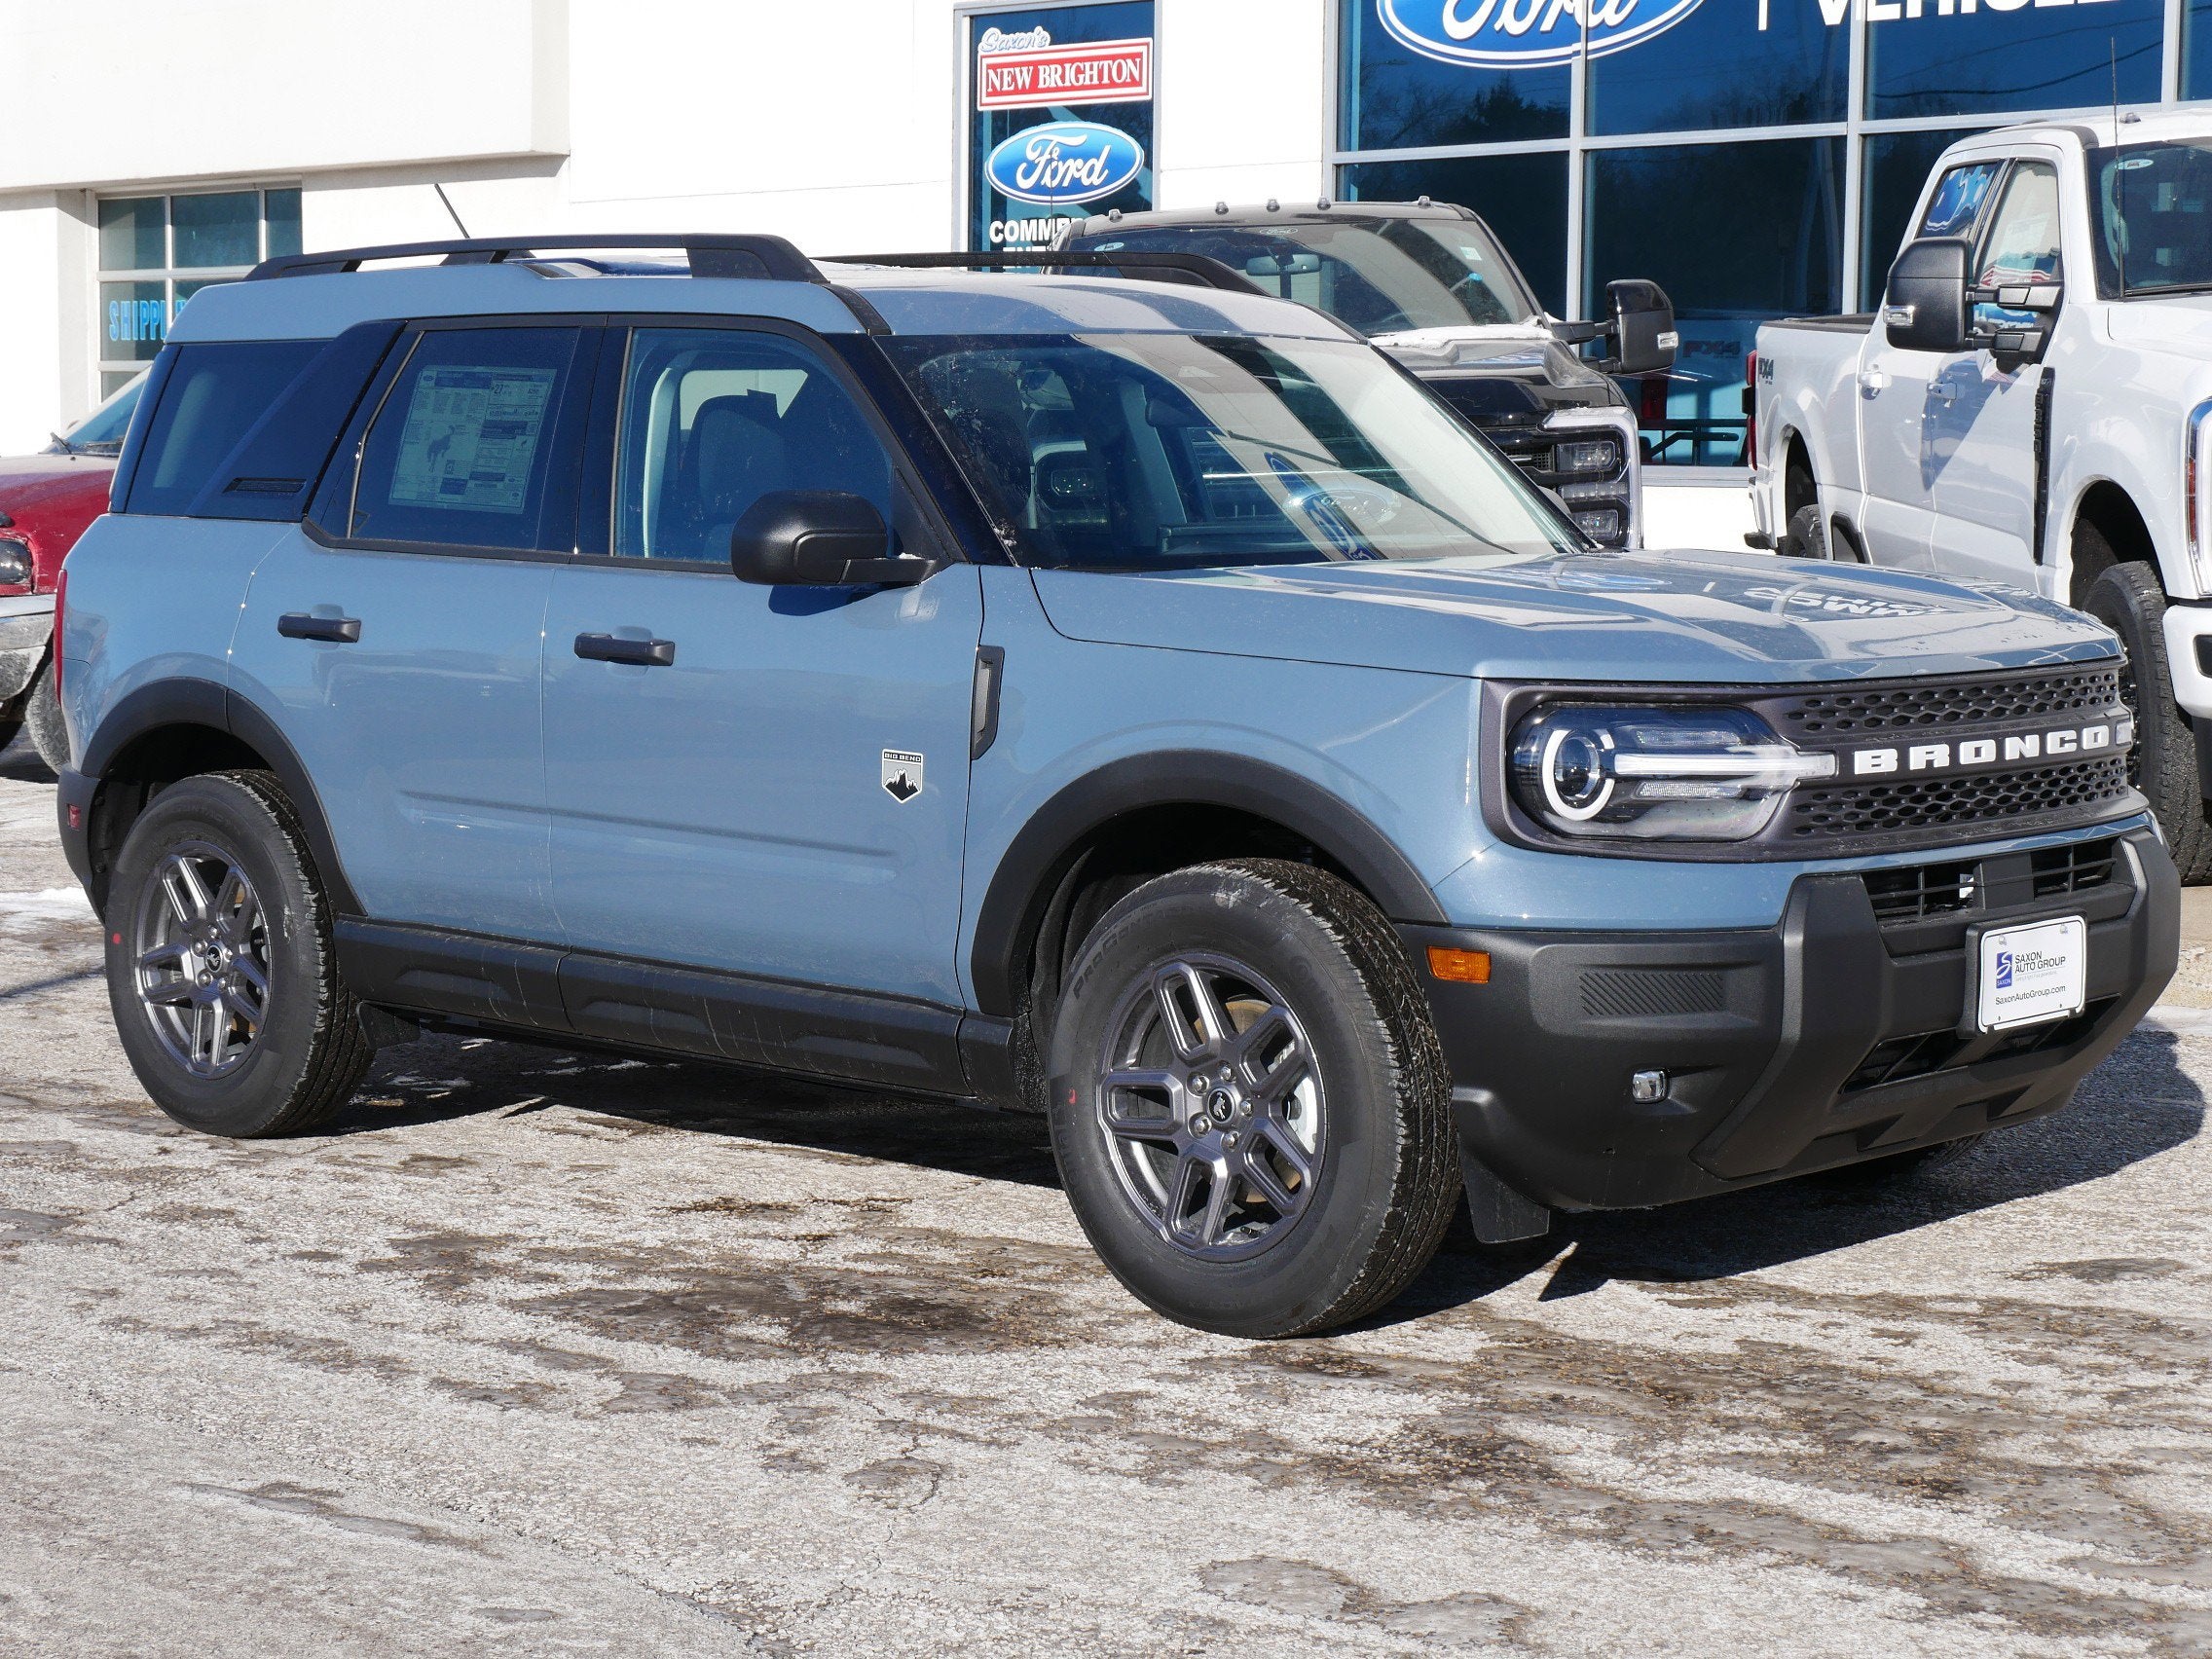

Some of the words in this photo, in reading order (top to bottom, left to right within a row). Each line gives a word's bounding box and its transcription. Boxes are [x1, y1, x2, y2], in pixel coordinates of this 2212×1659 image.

[979, 28, 1048, 52] Saxon's
[986, 66, 1034, 92] NEW
[1038, 57, 1141, 89] BRIGHTON
[1015, 133, 1112, 190] Ford
[109, 300, 187, 341] SHIPPI
[1854, 725, 2110, 775] BRONCO
[2014, 951, 2042, 964] SAXON
[2014, 961, 2036, 974] AUTO
[2037, 956, 2066, 970] GROUP
[1995, 985, 2066, 1006] SaxonAutoGroup.com
